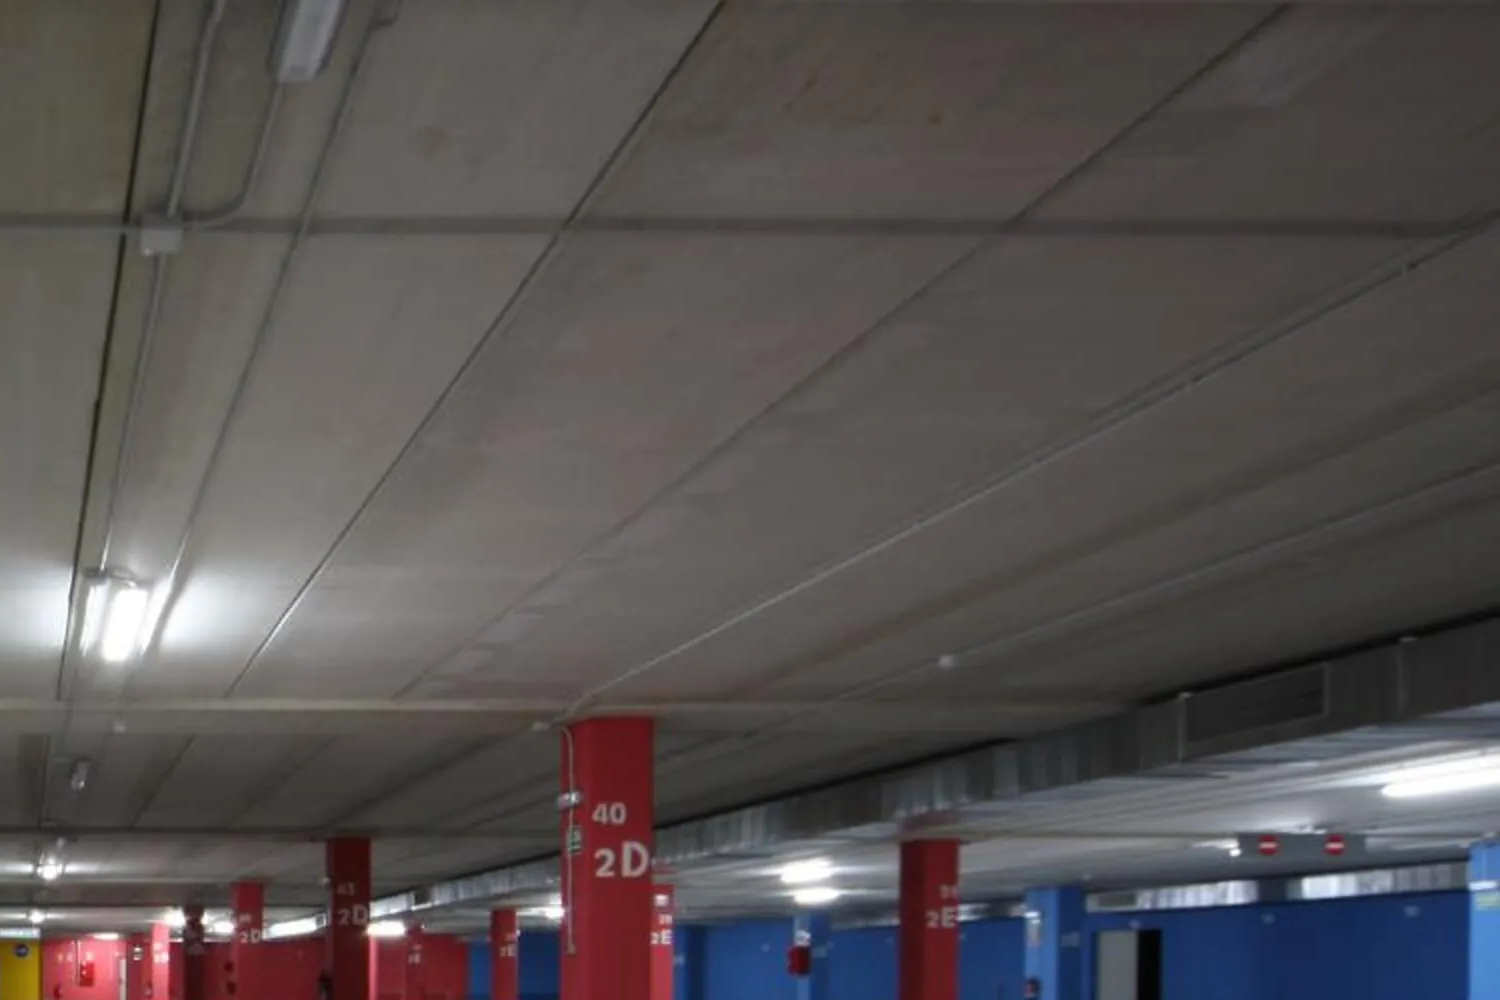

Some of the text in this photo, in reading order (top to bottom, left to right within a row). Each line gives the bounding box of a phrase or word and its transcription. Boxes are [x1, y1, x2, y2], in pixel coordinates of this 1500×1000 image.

[592, 802, 627, 825] 40
[594, 841, 649, 878] 2D
[337, 903, 368, 926] 2D
[925, 906, 956, 929] 2E
